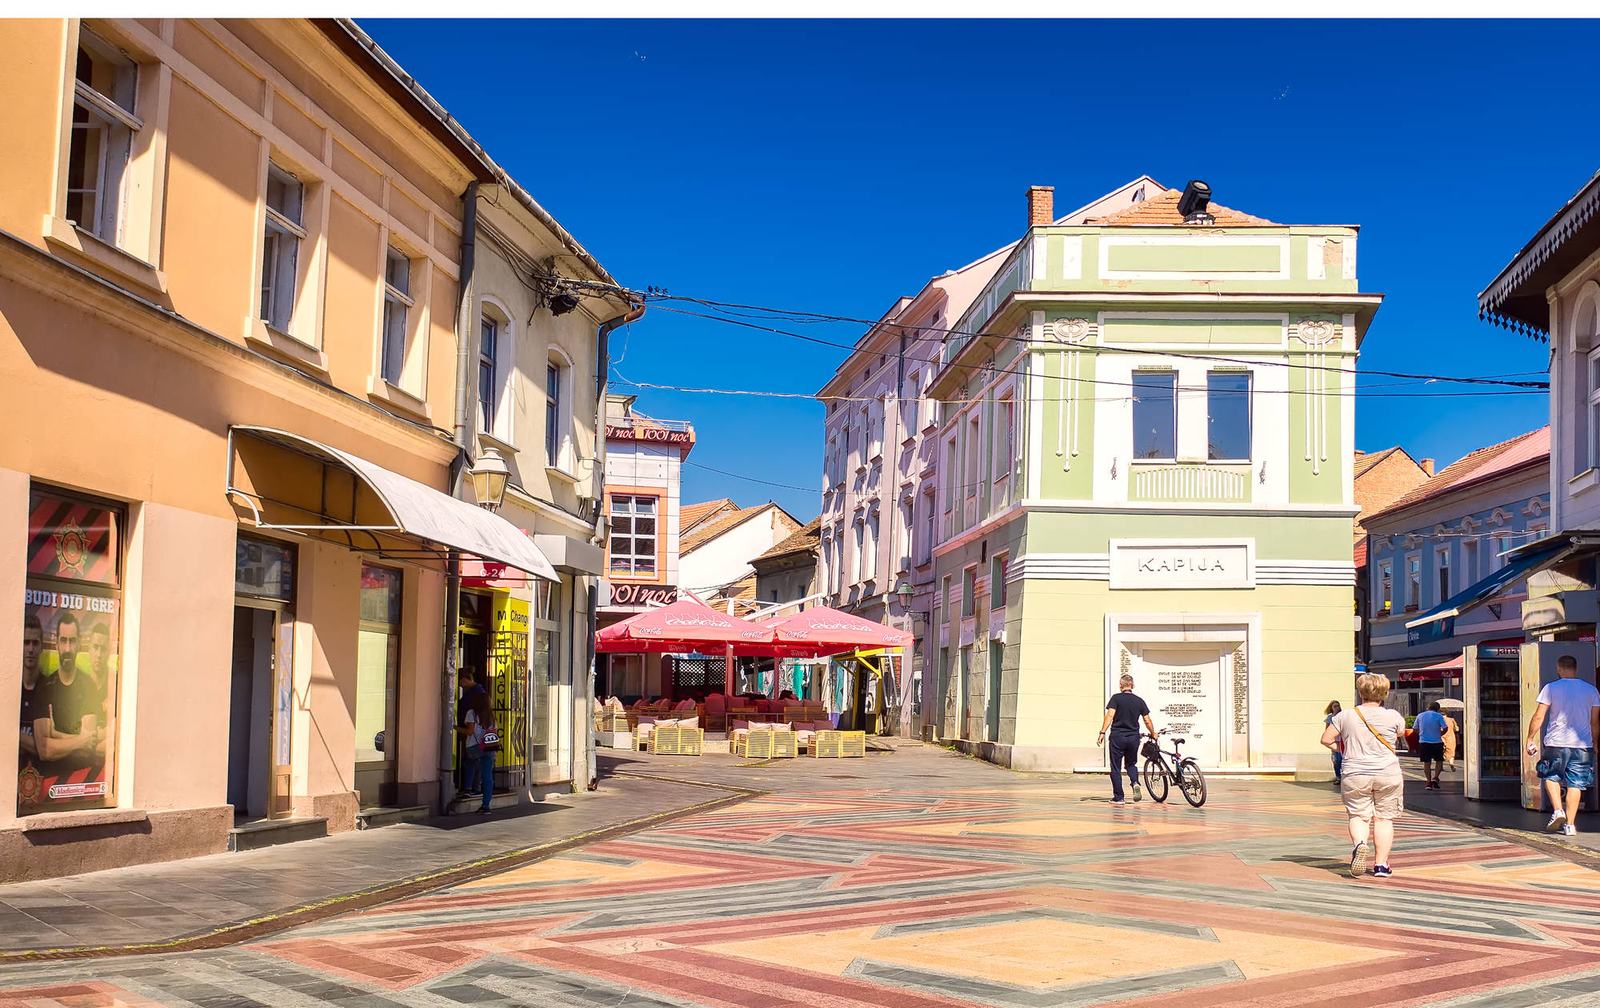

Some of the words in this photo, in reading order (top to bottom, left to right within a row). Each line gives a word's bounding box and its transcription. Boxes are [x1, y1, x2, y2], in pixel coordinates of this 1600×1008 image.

[645, 429, 669, 440] 1001
[1138, 557, 1225, 572] KAPIJA
[26, 588, 58, 607] BUDI
[60, 593, 83, 609] DIO
[86, 596, 115, 614] IGRE
[609, 584, 641, 603] 01
[640, 587, 677, 604] noć
[510, 609, 528, 626] Chang
